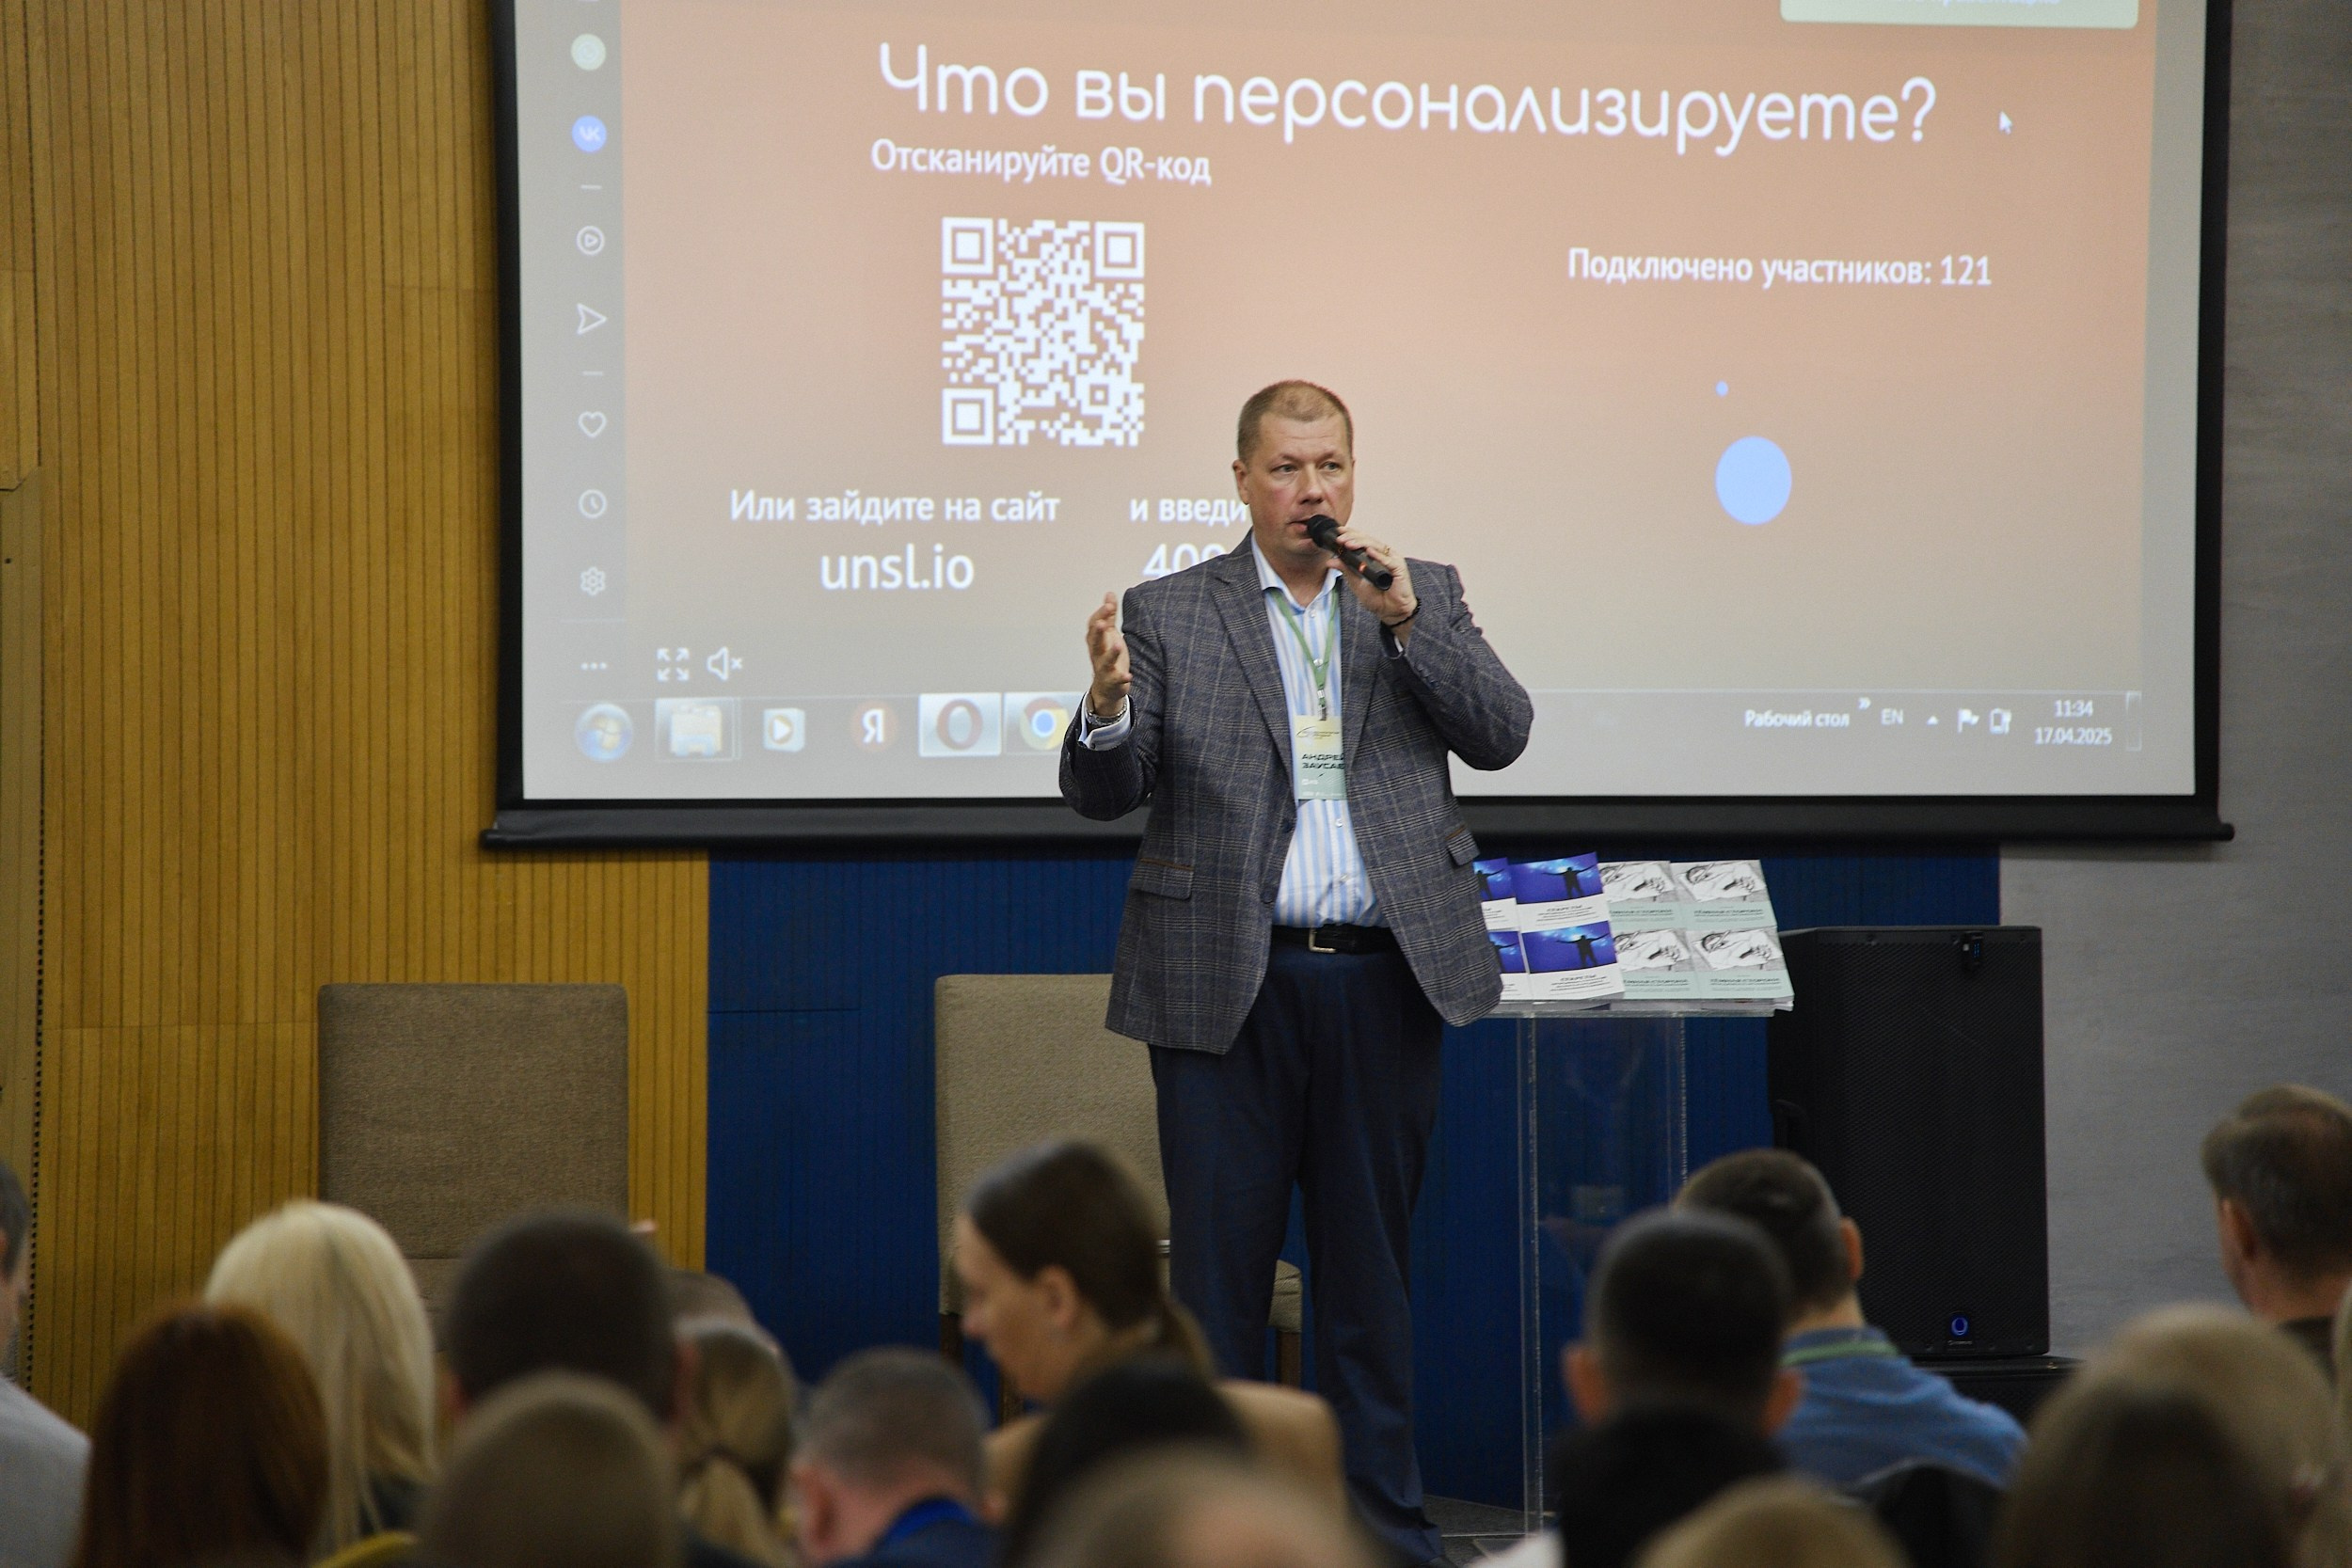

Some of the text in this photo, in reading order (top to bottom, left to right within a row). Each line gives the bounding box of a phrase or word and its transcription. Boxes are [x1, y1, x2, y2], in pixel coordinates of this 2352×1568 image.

[878, 40, 1938, 158] Что вы персонализируете?
[870, 138, 1213, 186] Отсканируйте QR-код
[1567, 246, 1993, 290] Подключено участников: 121
[731, 489, 1061, 526] Или зайдите на сайт
[1129, 498, 1149, 523] и
[820, 543, 976, 591] unsl.io
[1744, 709, 1851, 730] Рабочий стол
[1881, 707, 1904, 726] EN
[2054, 699, 2094, 718] 11:34
[2034, 725, 2113, 746] 17.04.2025
